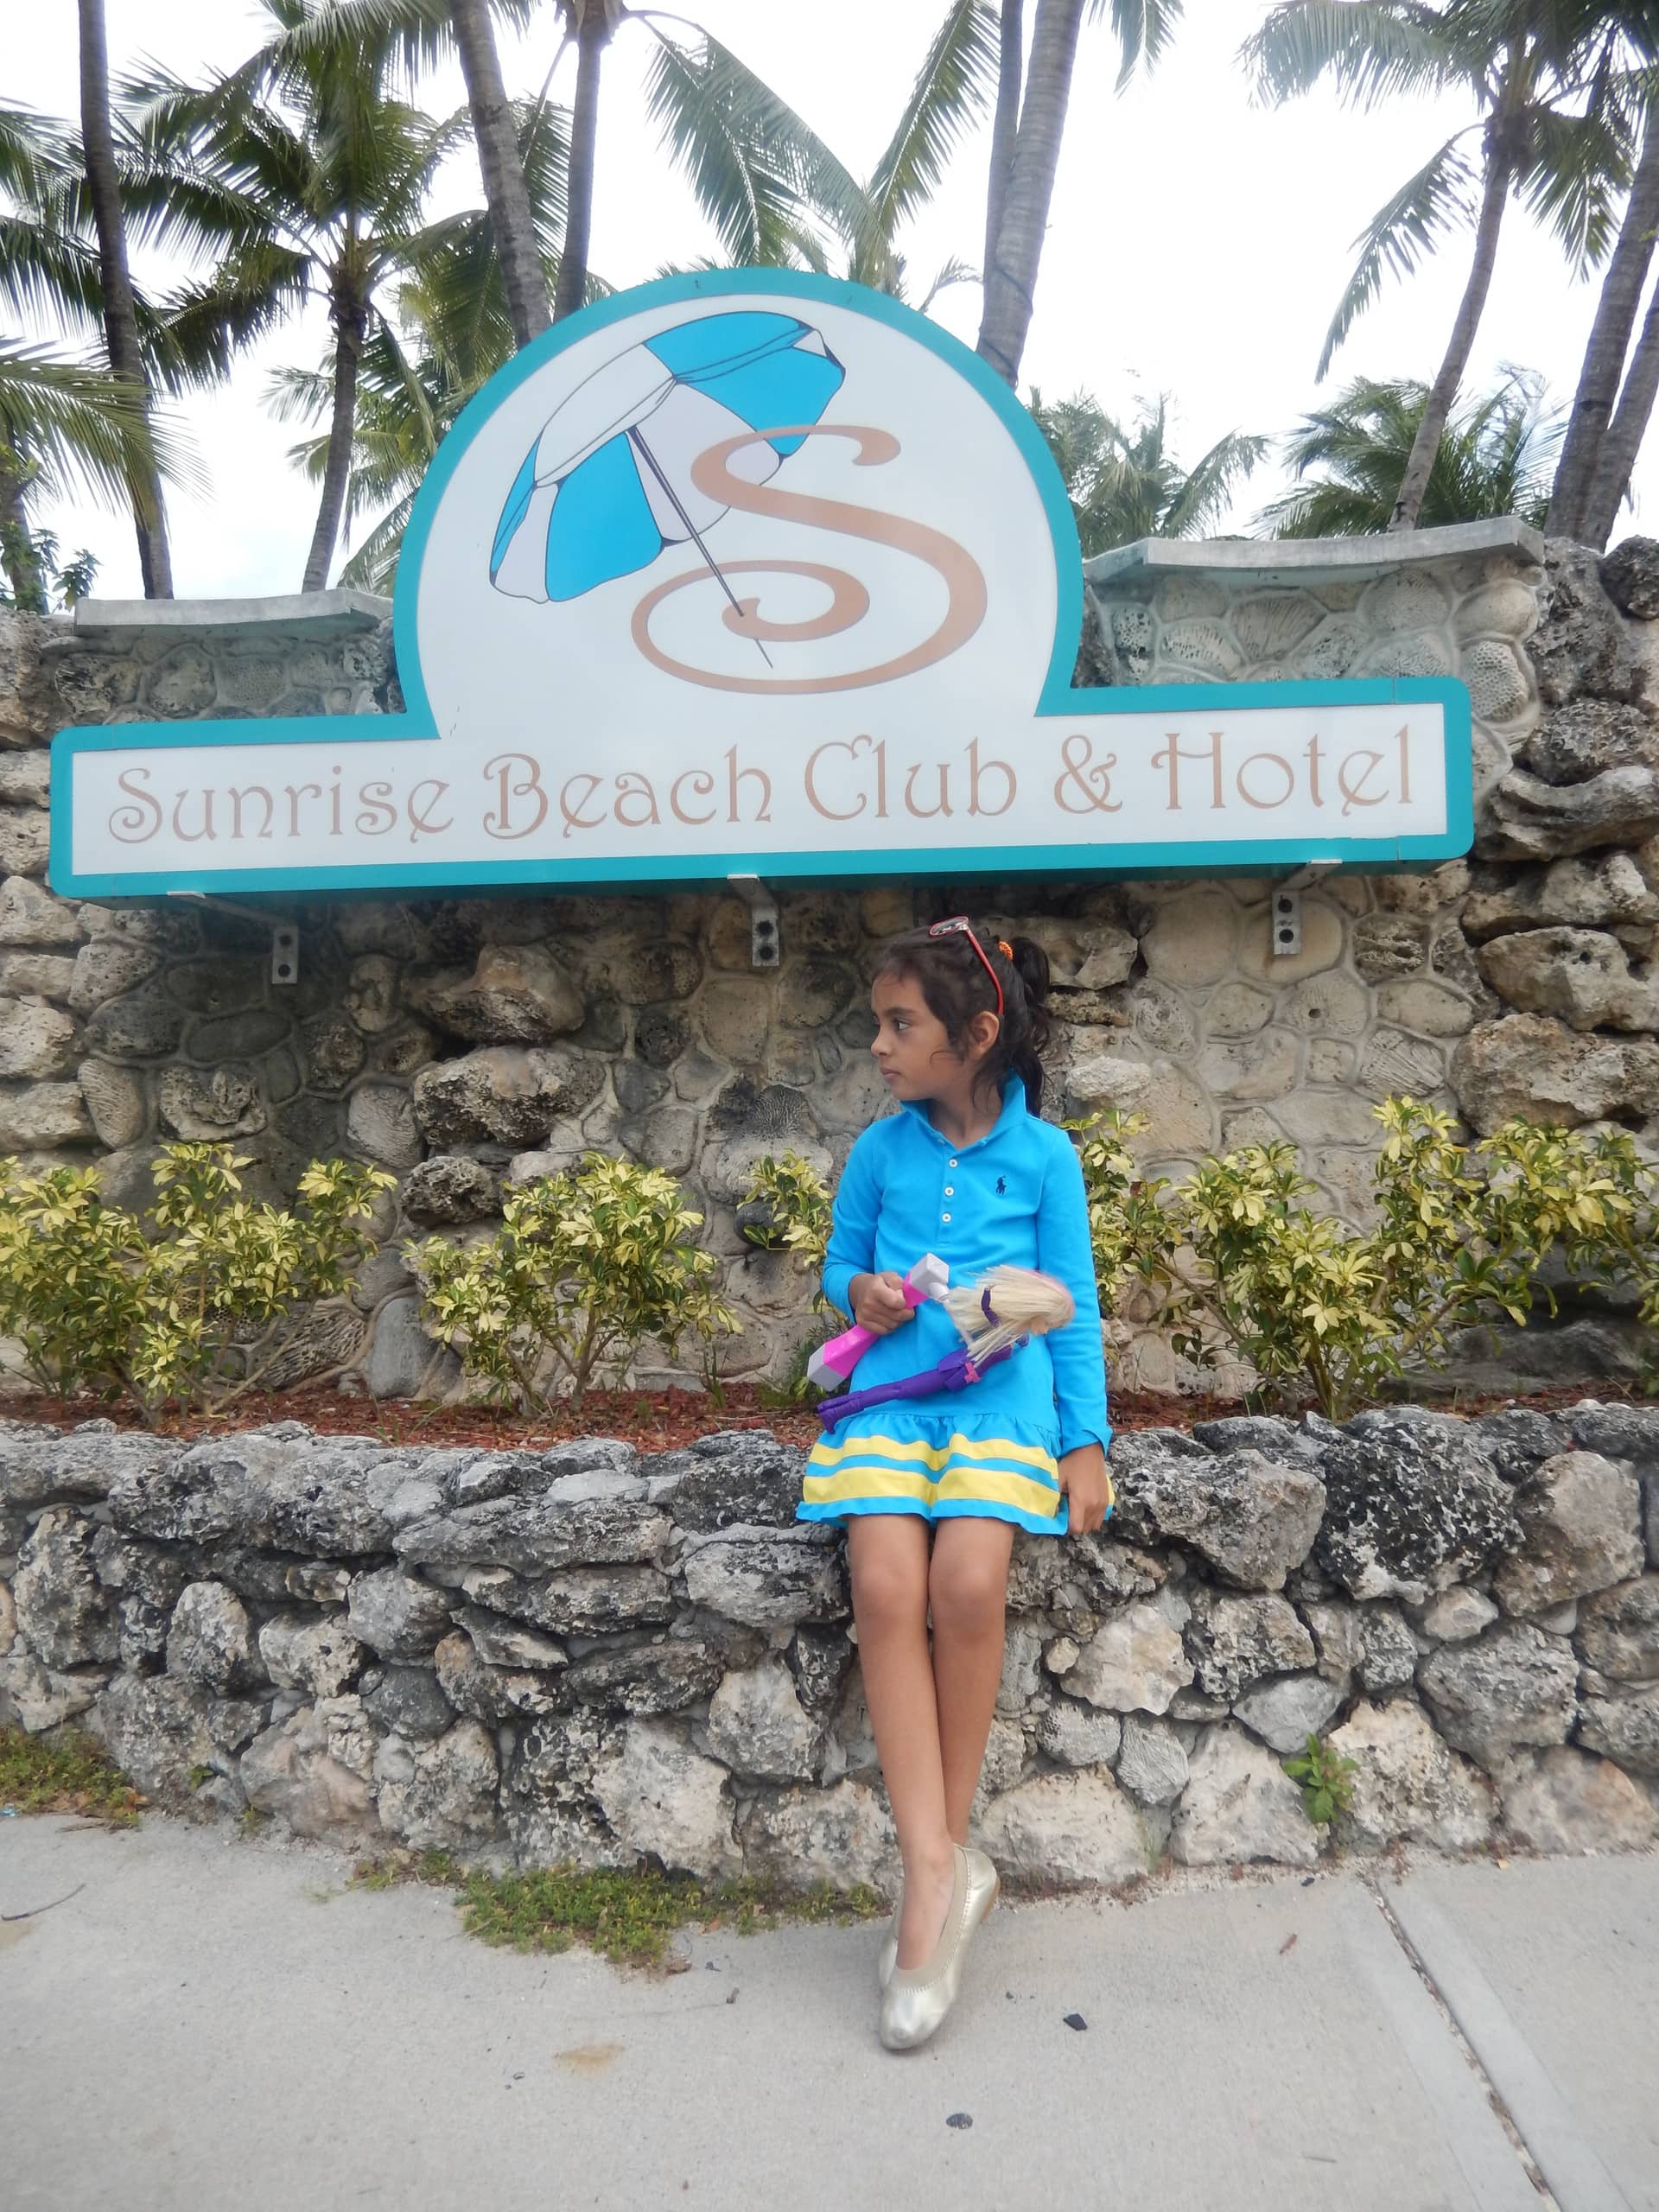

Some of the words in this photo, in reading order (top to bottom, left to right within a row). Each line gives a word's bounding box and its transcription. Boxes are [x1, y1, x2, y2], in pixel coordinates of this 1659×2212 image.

[631, 424, 988, 695] S
[108, 765, 454, 844] Sunrise
[482, 745, 772, 841] Beach
[804, 734, 1017, 821] Club
[1053, 734, 1123, 815] &
[1151, 723, 1414, 817] Hotel
